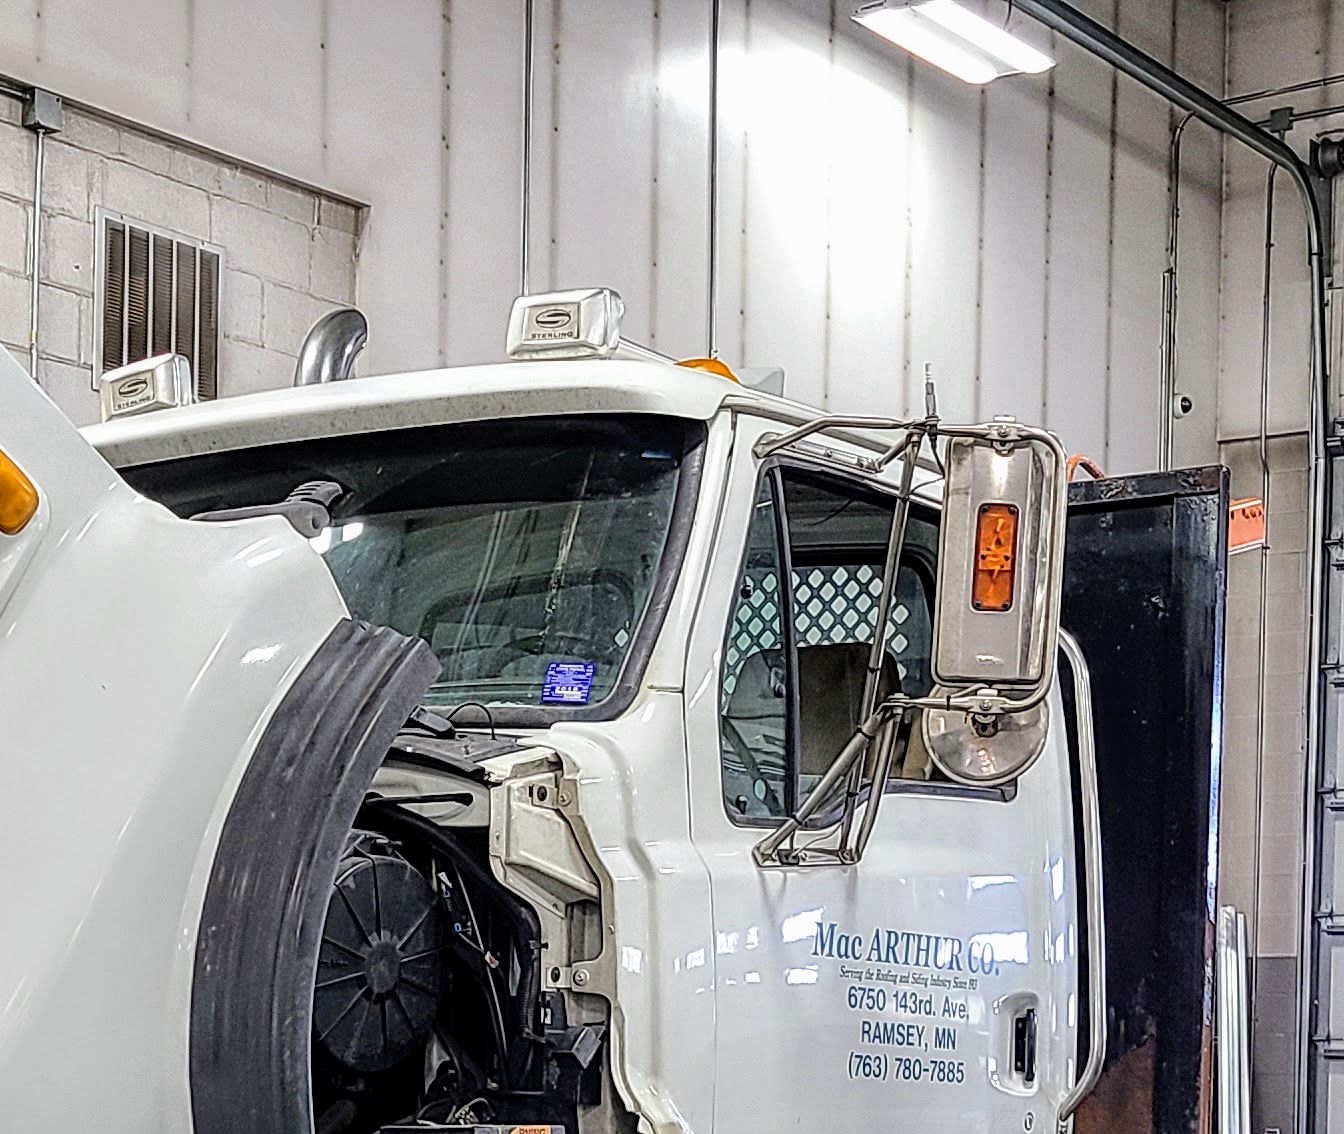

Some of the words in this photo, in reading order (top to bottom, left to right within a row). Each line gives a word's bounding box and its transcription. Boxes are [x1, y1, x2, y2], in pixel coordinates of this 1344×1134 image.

[531, 331, 574, 339] STERLING
[811, 921, 863, 961] Mac
[865, 928, 963, 971] ARTHUR
[967, 941, 1000, 976] CO.
[839, 964, 863, 982] Serving
[865, 968, 874, 980] the
[875, 968, 898, 985] Roofing
[899, 971, 910, 984] and
[847, 985, 887, 1012] 6750
[892, 990, 936, 1017] 143rd.
[860, 1020, 928, 1053] RAMSEY,
[934, 1027, 957, 1051] MN
[848, 1051, 888, 1081] (763)
[894, 1057, 965, 1084] 780-7885
